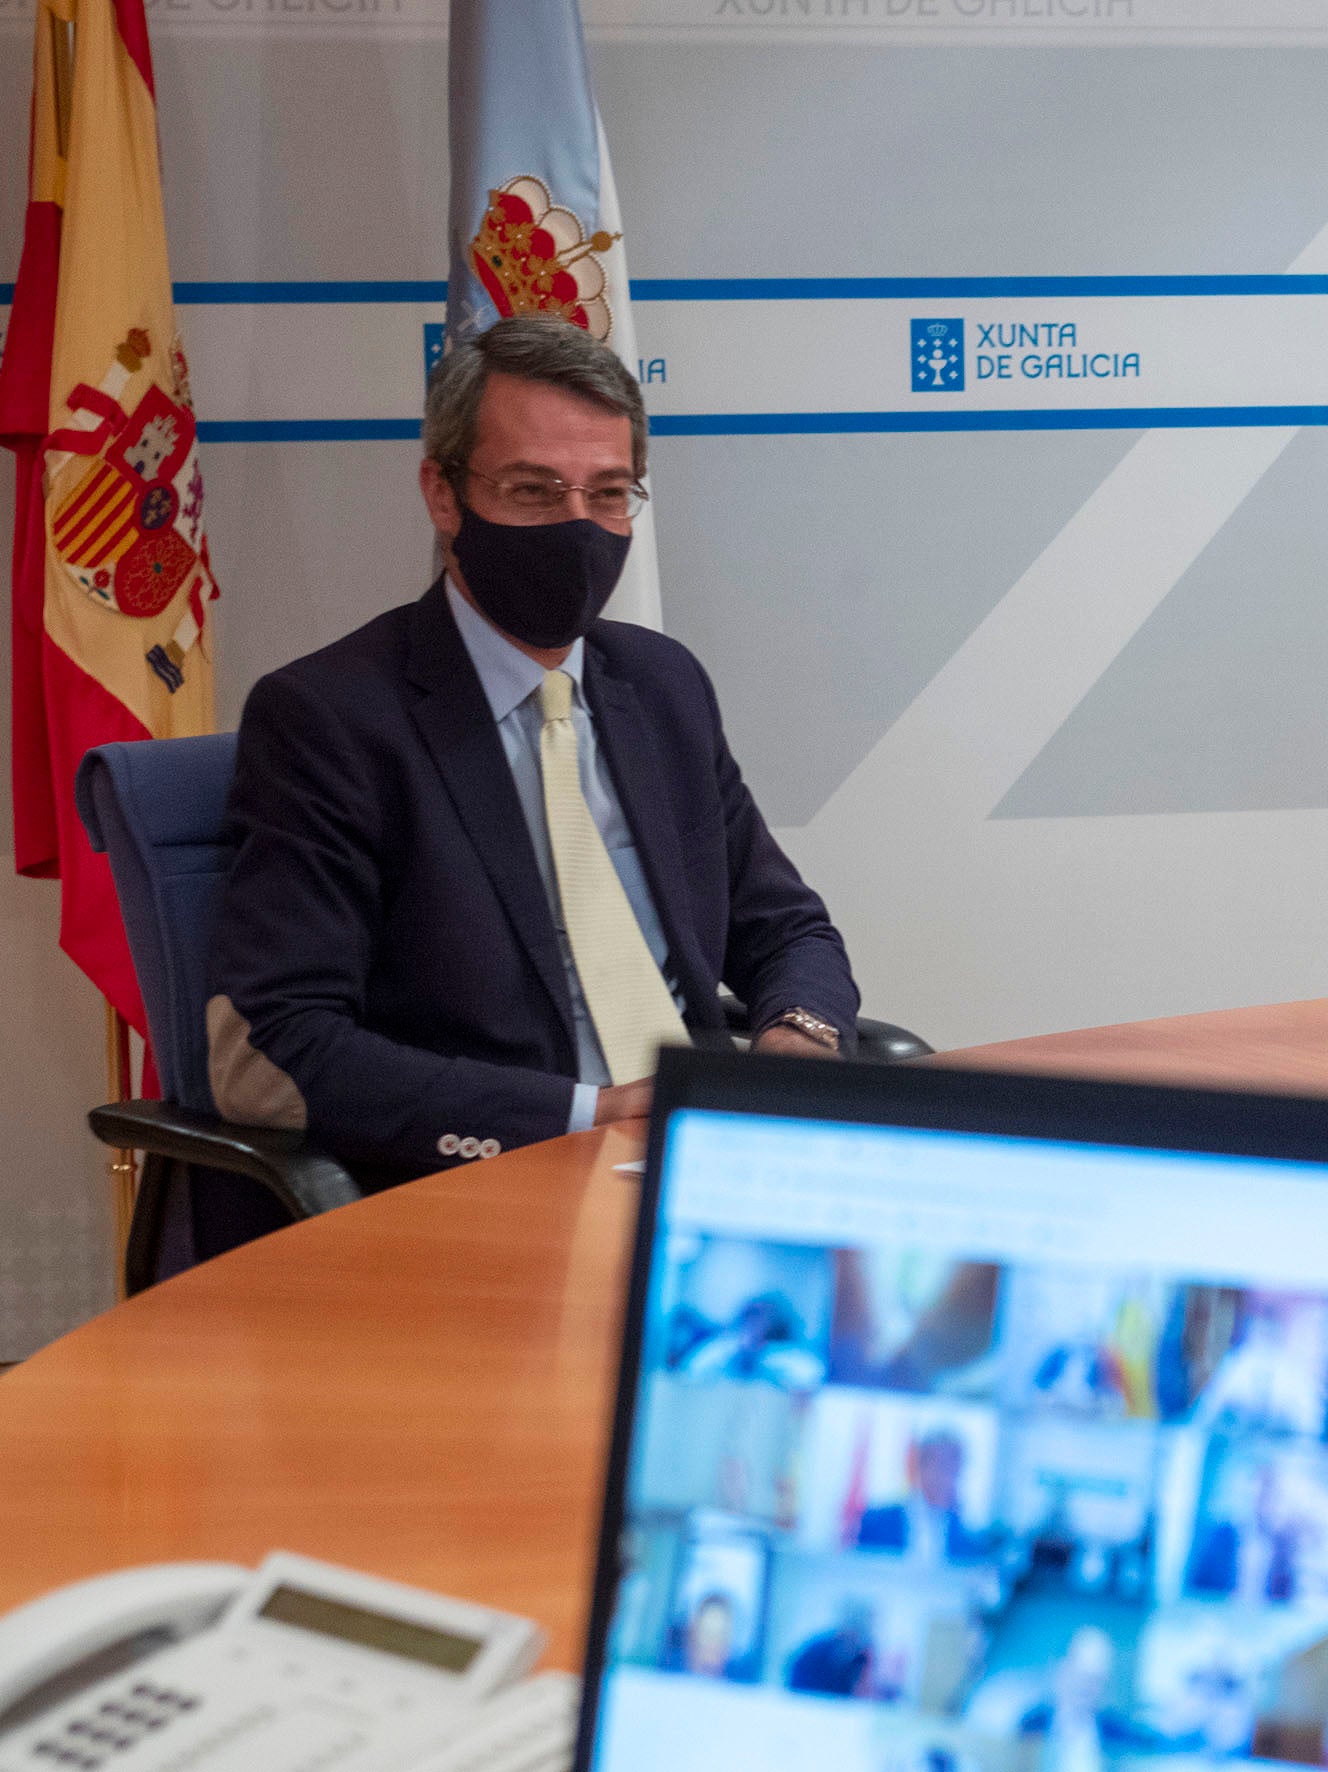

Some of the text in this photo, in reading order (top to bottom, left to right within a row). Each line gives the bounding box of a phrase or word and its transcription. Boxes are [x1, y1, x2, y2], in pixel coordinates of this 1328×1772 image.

[976, 323, 1077, 348] XUNTA
[976, 353, 1140, 379] DE GALICIA
